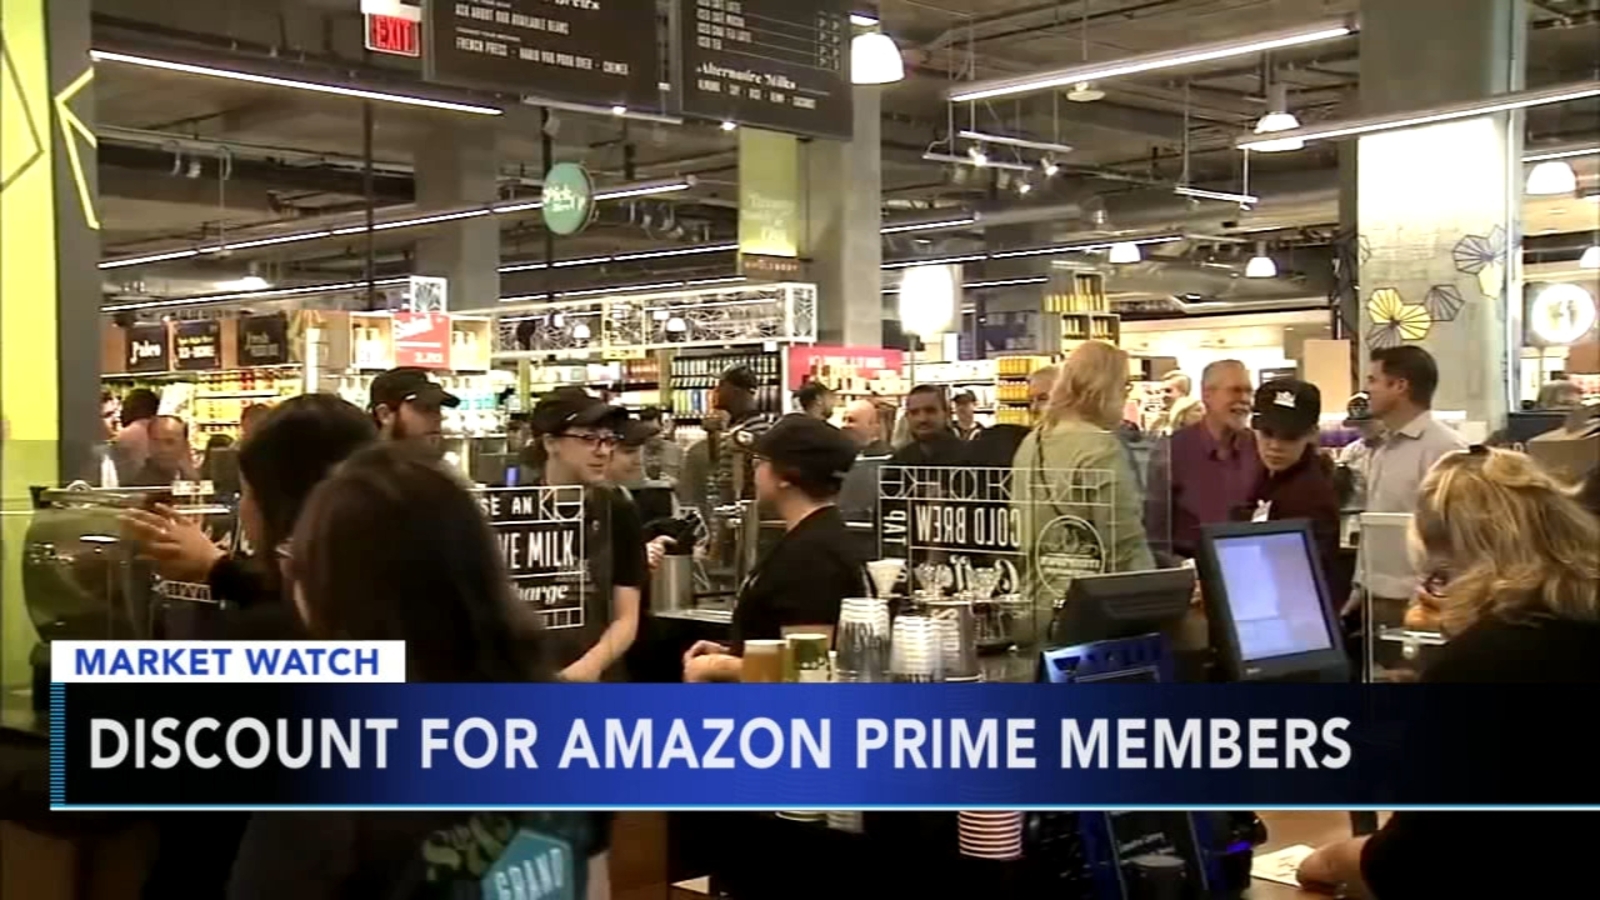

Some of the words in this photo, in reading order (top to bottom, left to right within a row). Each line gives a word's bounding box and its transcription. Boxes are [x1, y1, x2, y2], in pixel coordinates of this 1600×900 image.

[375, 18, 413, 51] EXIT
[511, 496, 533, 515] AN
[528, 529, 574, 569] MILK
